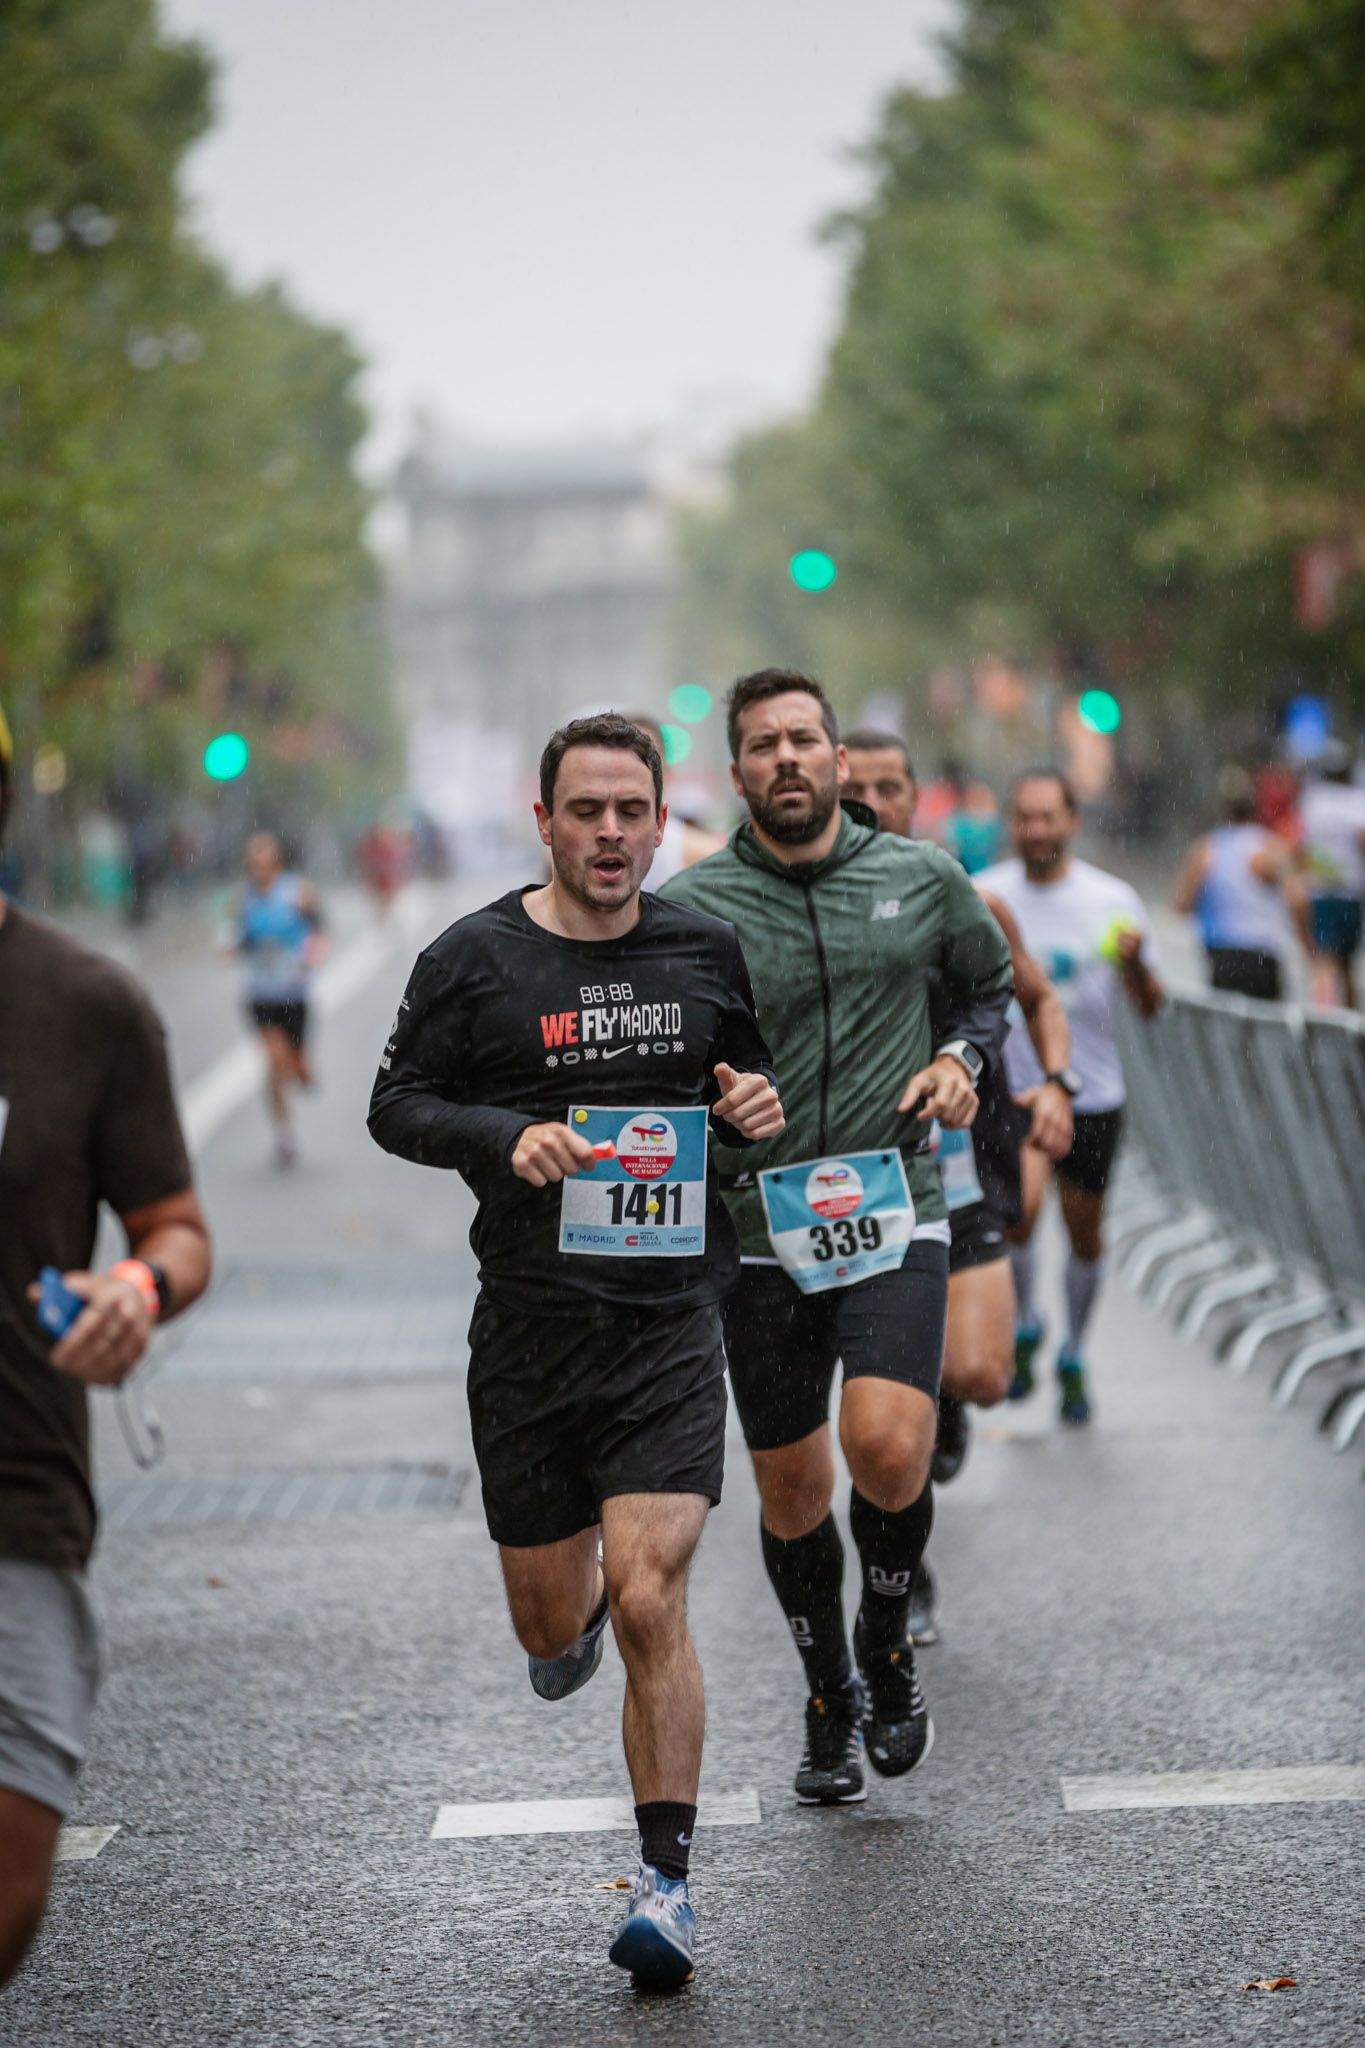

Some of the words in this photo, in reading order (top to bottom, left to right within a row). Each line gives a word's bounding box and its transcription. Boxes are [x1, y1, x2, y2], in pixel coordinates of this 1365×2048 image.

[580, 983, 634, 1004] 88:88
[540, 1011, 579, 1048] WE
[581, 1006, 618, 1042] FLY
[620, 1003, 681, 1038] MADRID
[606, 1183, 682, 1225] 1411
[579, 1234, 616, 1244] MADRID
[809, 1216, 882, 1261] 339
